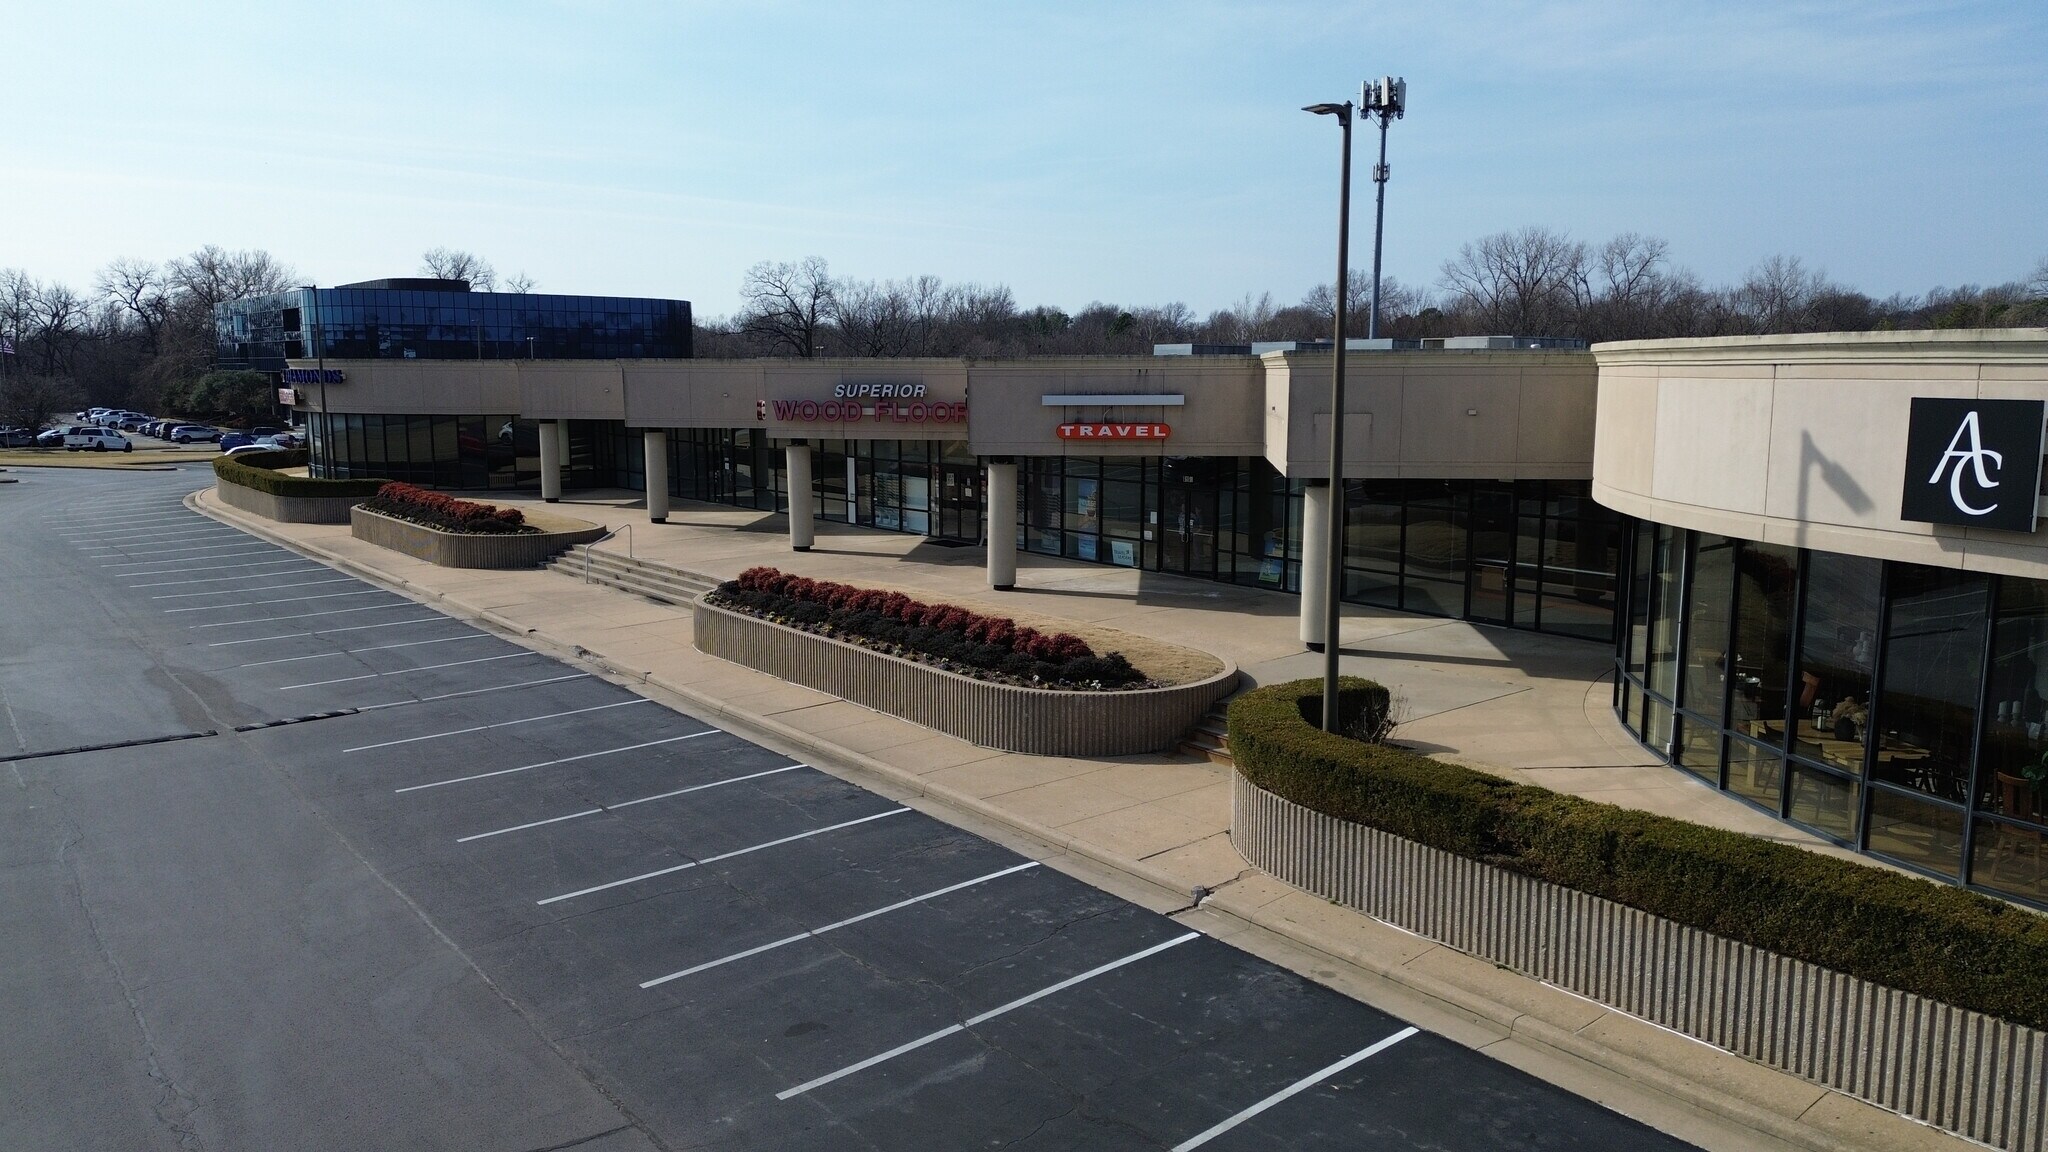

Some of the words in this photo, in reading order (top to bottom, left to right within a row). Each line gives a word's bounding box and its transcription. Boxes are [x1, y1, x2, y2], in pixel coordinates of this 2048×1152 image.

[834, 384, 926, 398] SUPERIOR
[772, 399, 863, 422] WOOD
[1060, 425, 1167, 437] TRAVEL
[1928, 411, 2003, 516] AC
